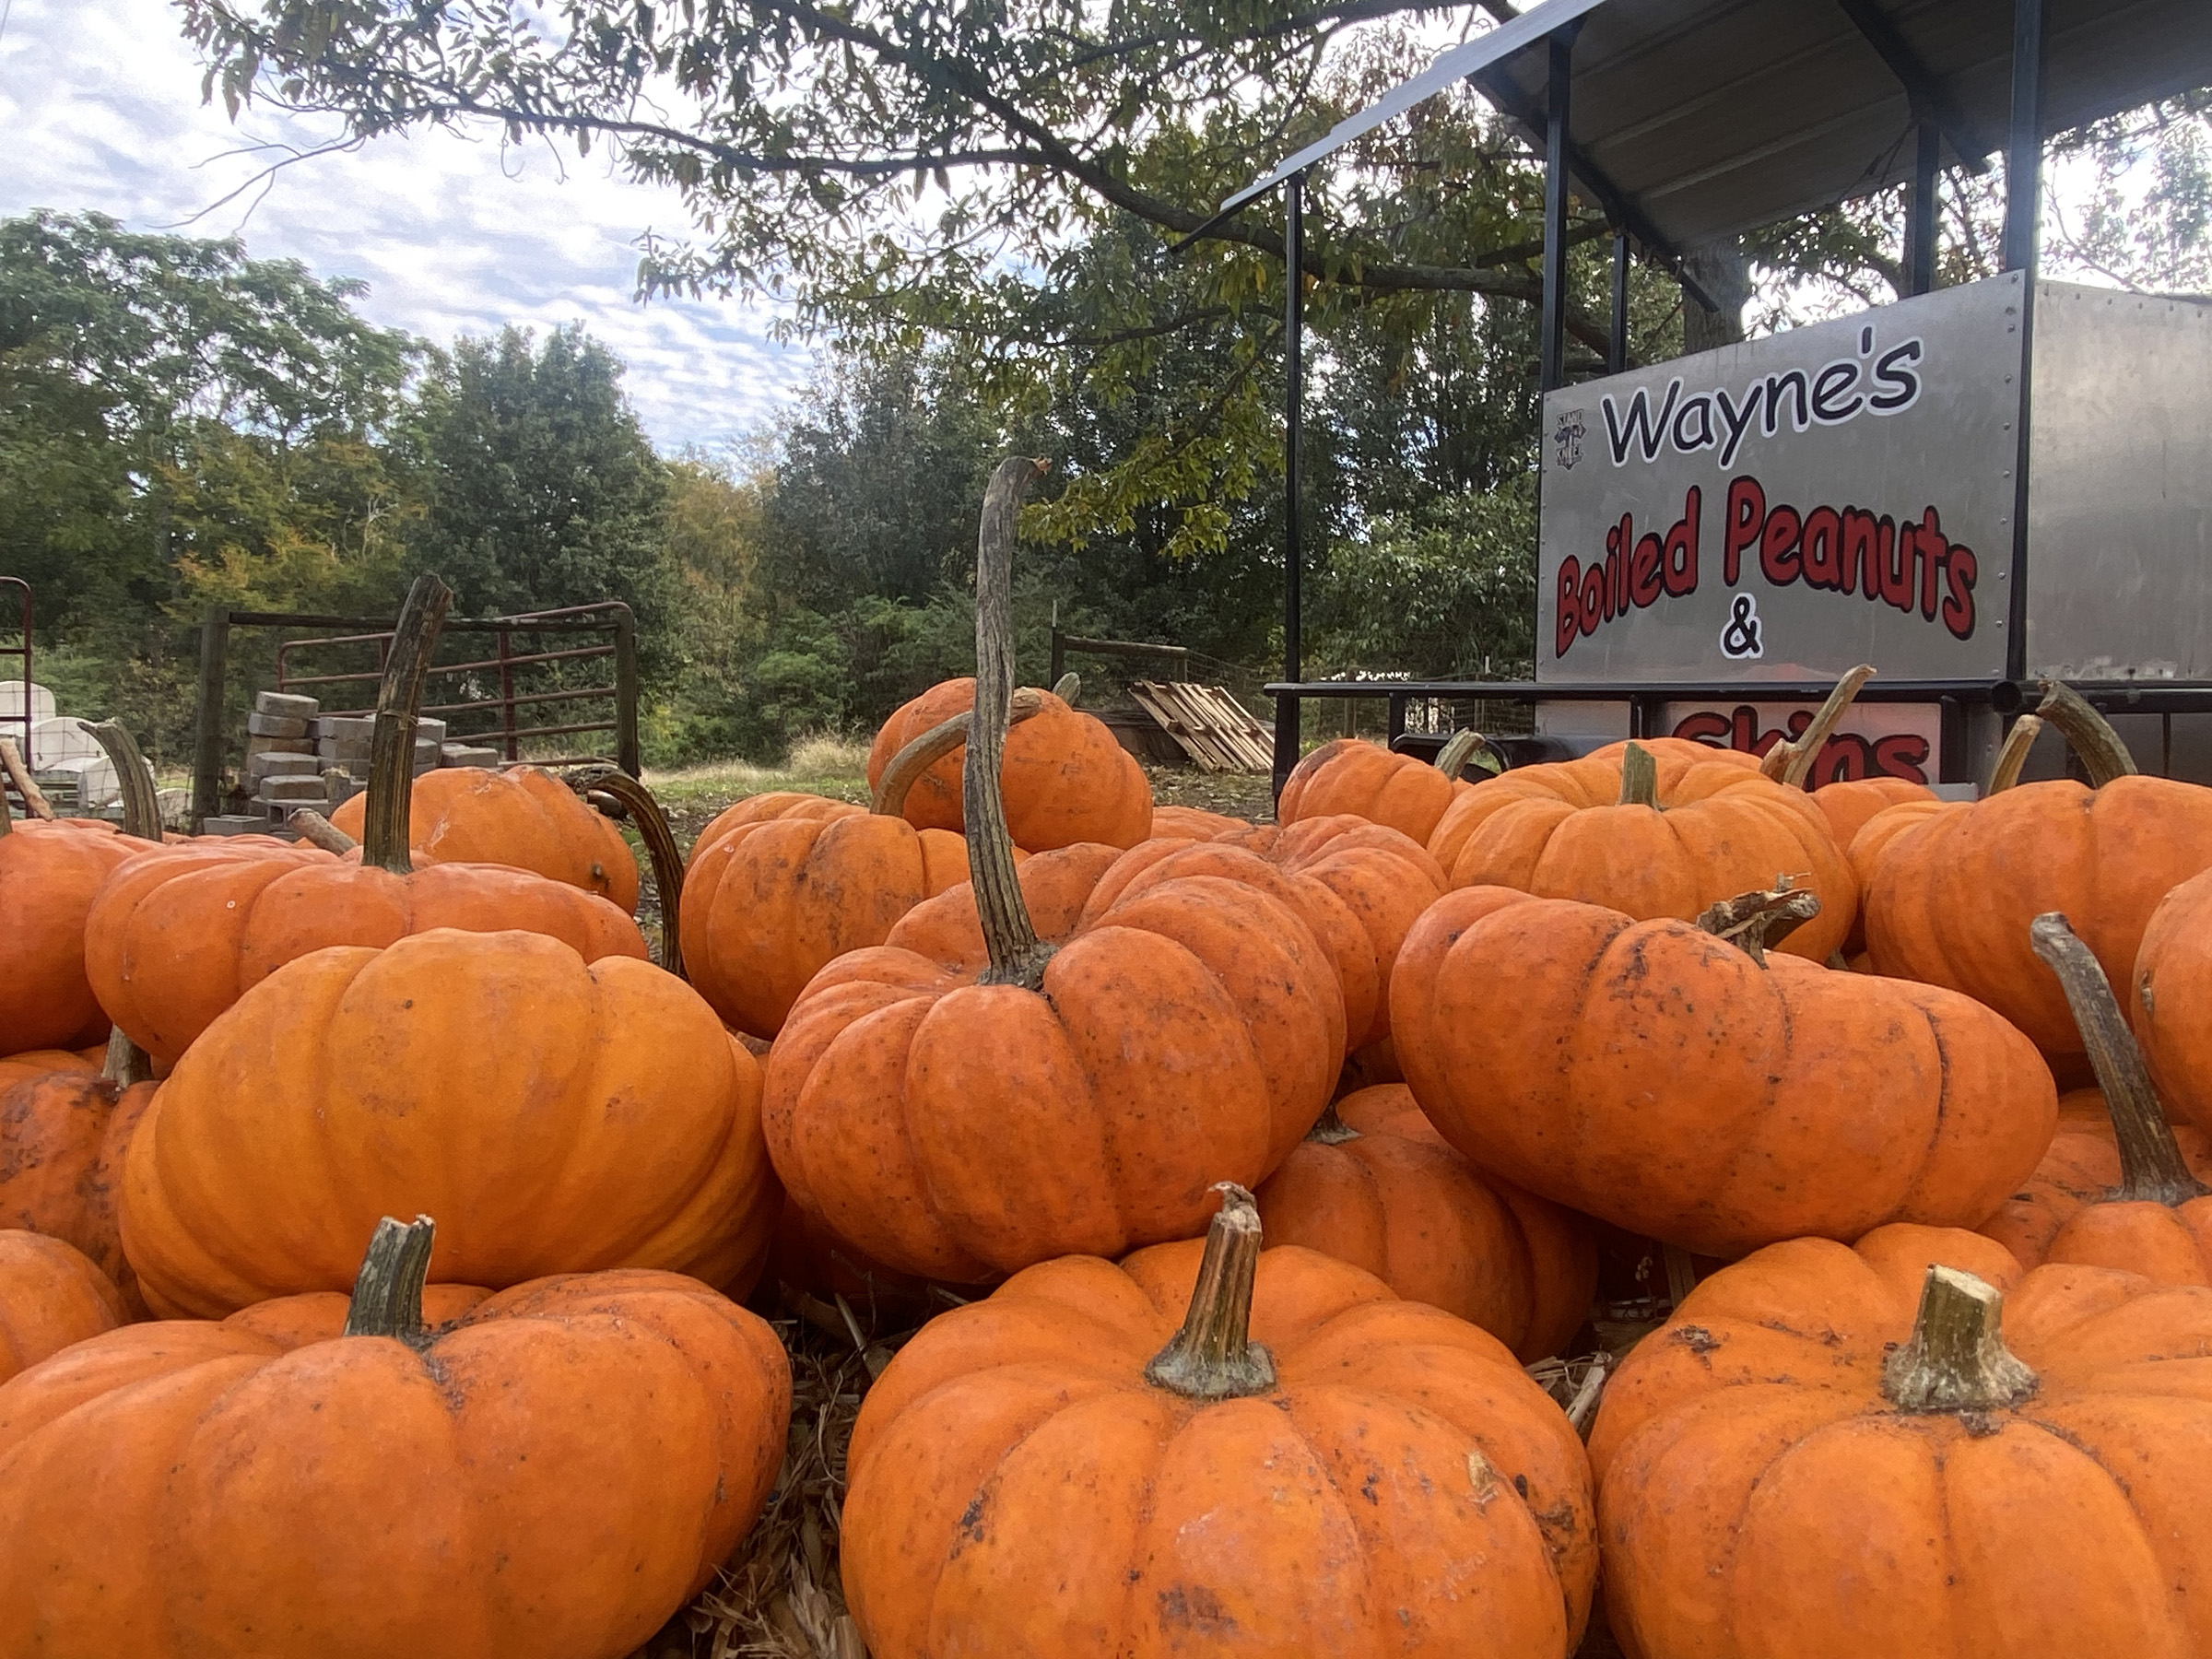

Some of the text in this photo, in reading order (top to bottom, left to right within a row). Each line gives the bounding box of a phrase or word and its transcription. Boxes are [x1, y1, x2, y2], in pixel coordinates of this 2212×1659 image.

[1602, 323, 1923, 469] Wayne's
[1556, 476, 1977, 658] Boiled Peanuts
[1721, 593, 1763, 658] &
